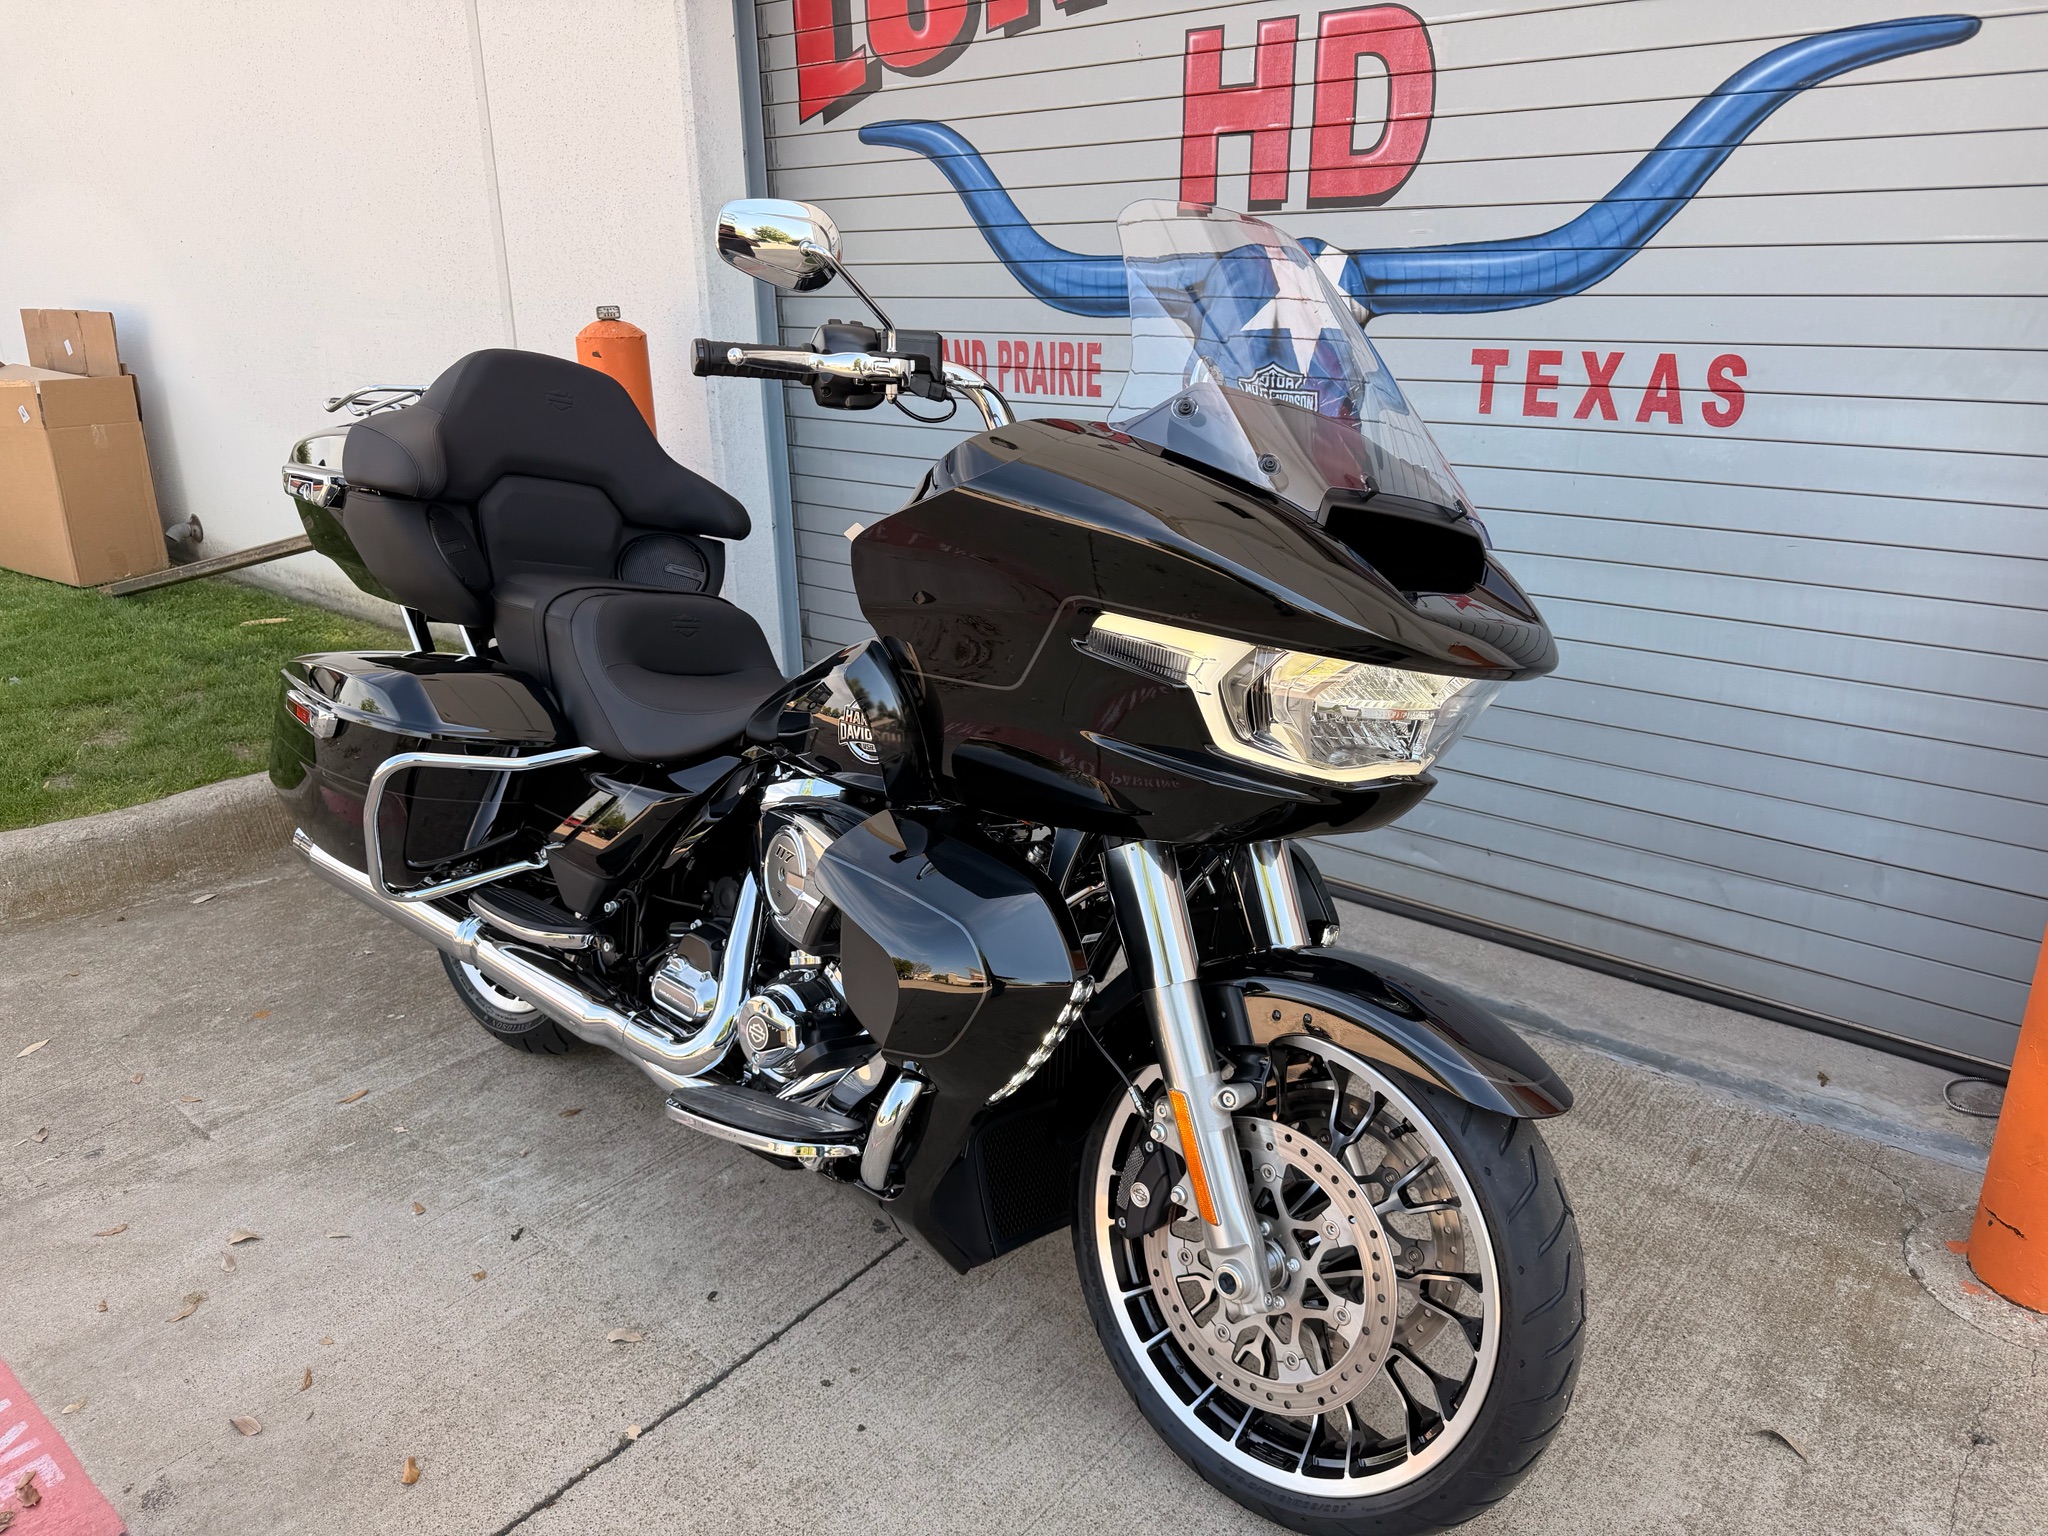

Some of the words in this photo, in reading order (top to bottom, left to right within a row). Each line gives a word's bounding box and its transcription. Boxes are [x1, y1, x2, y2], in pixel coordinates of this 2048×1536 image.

[1178, 3, 1436, 213] HD
[997, 339, 1102, 398] PRAIRIE
[1471, 348, 1748, 428] TEXAS
[774, 843, 796, 864] 117
